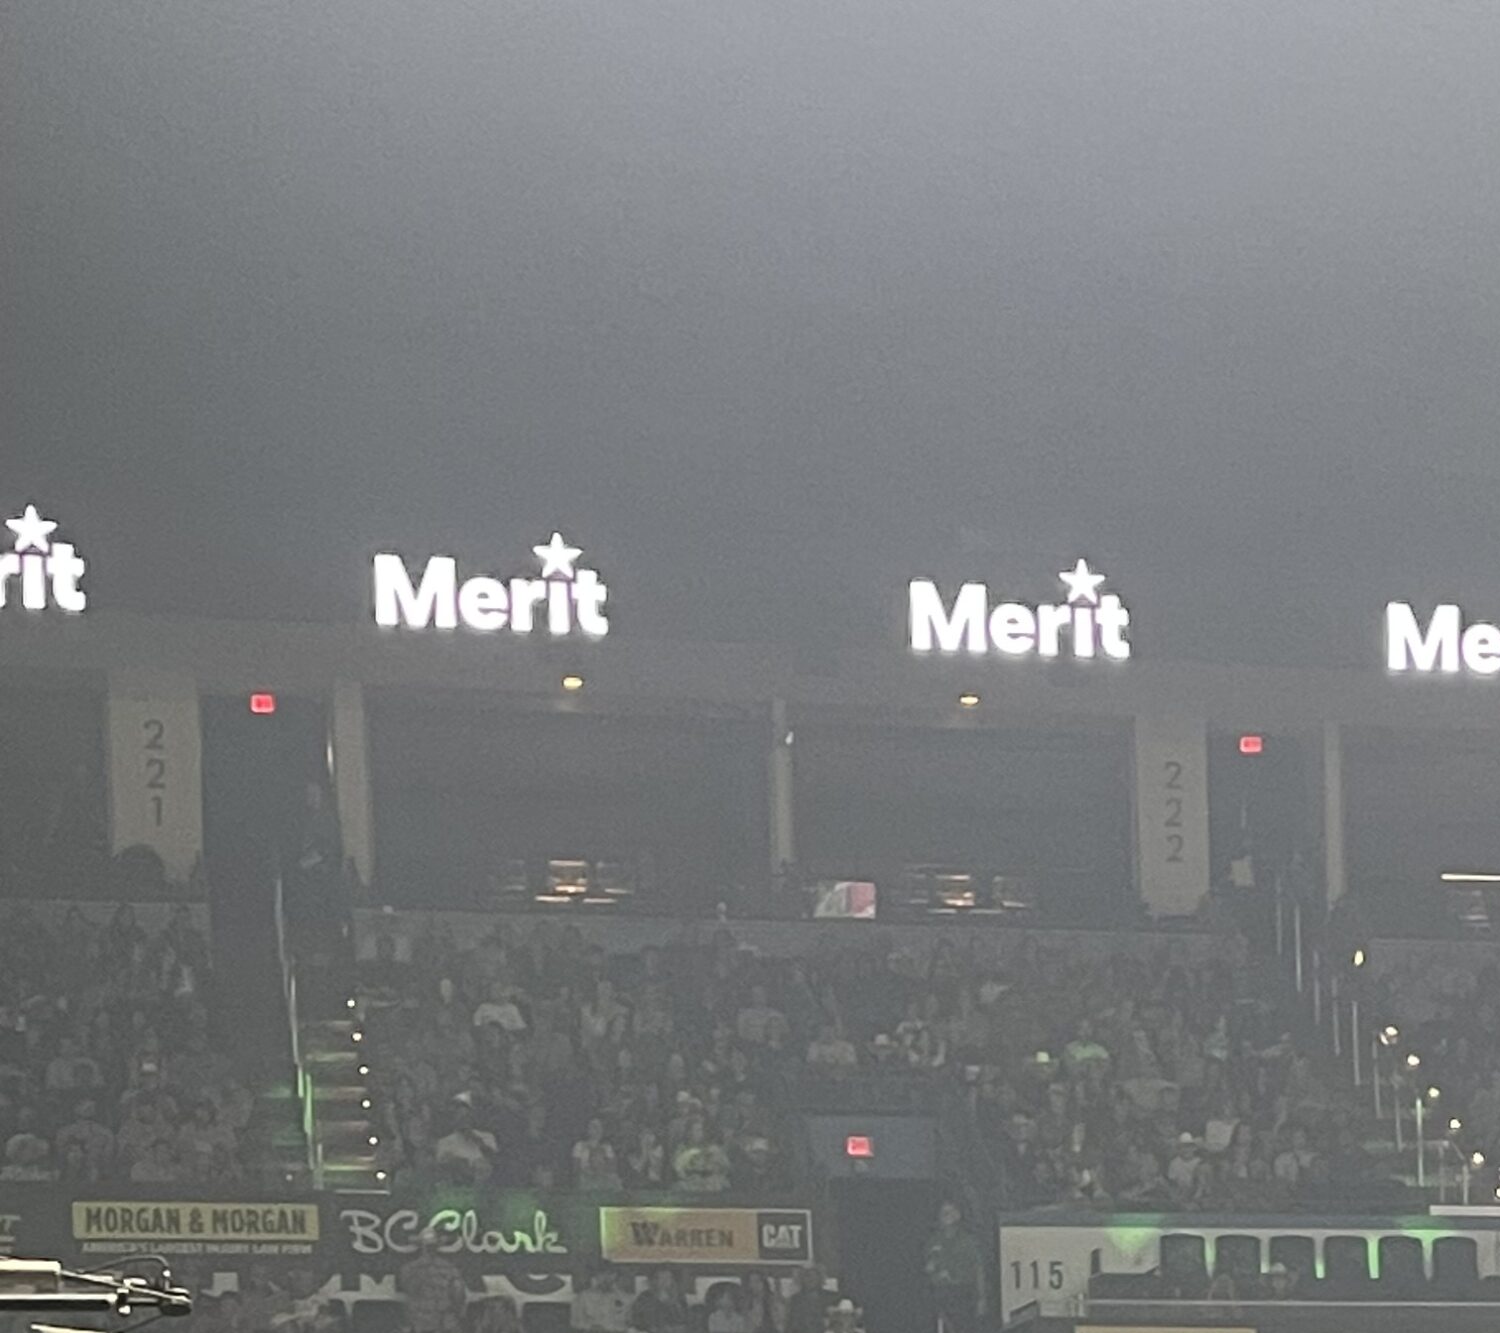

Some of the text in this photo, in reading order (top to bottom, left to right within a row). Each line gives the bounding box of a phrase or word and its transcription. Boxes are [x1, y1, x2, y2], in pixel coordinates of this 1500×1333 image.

[375, 533, 608, 635] Merit
[910, 559, 1129, 661] Merit
[85, 1207, 306, 1234] MORGAN & MORGAN
[421, 1209, 568, 1253] Clark
[762, 1223, 802, 1248] CAT
[1010, 1260, 1064, 1290] 115
